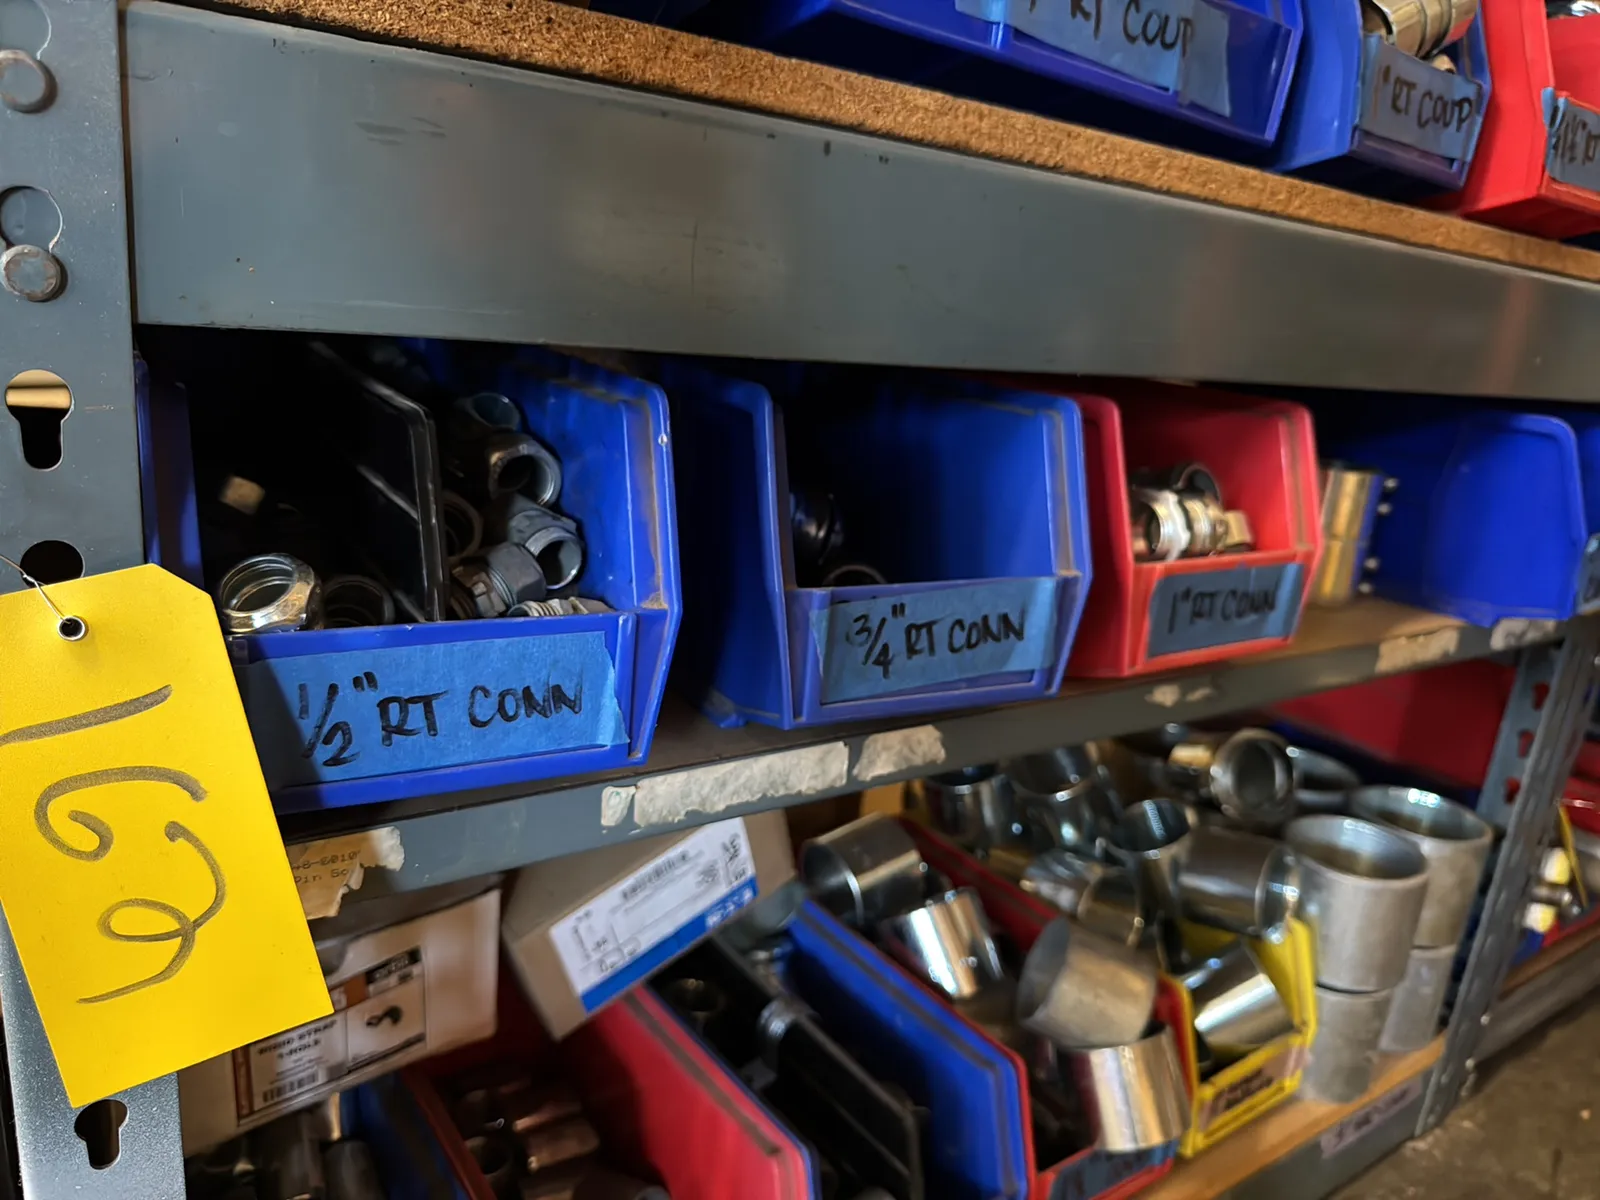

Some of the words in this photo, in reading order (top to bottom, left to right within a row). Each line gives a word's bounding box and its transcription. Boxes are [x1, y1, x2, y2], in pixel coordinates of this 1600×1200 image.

[1123, 0, 1195, 57] COUP
[1417, 89, 1473, 132] COUP
[846, 602, 905, 680] 3/4"
[905, 615, 942, 660] RT
[948, 607, 1025, 655] CONN
[298, 671, 377, 767] 1/2"
[377, 690, 448, 747] RT
[468, 677, 583, 728] CONN
